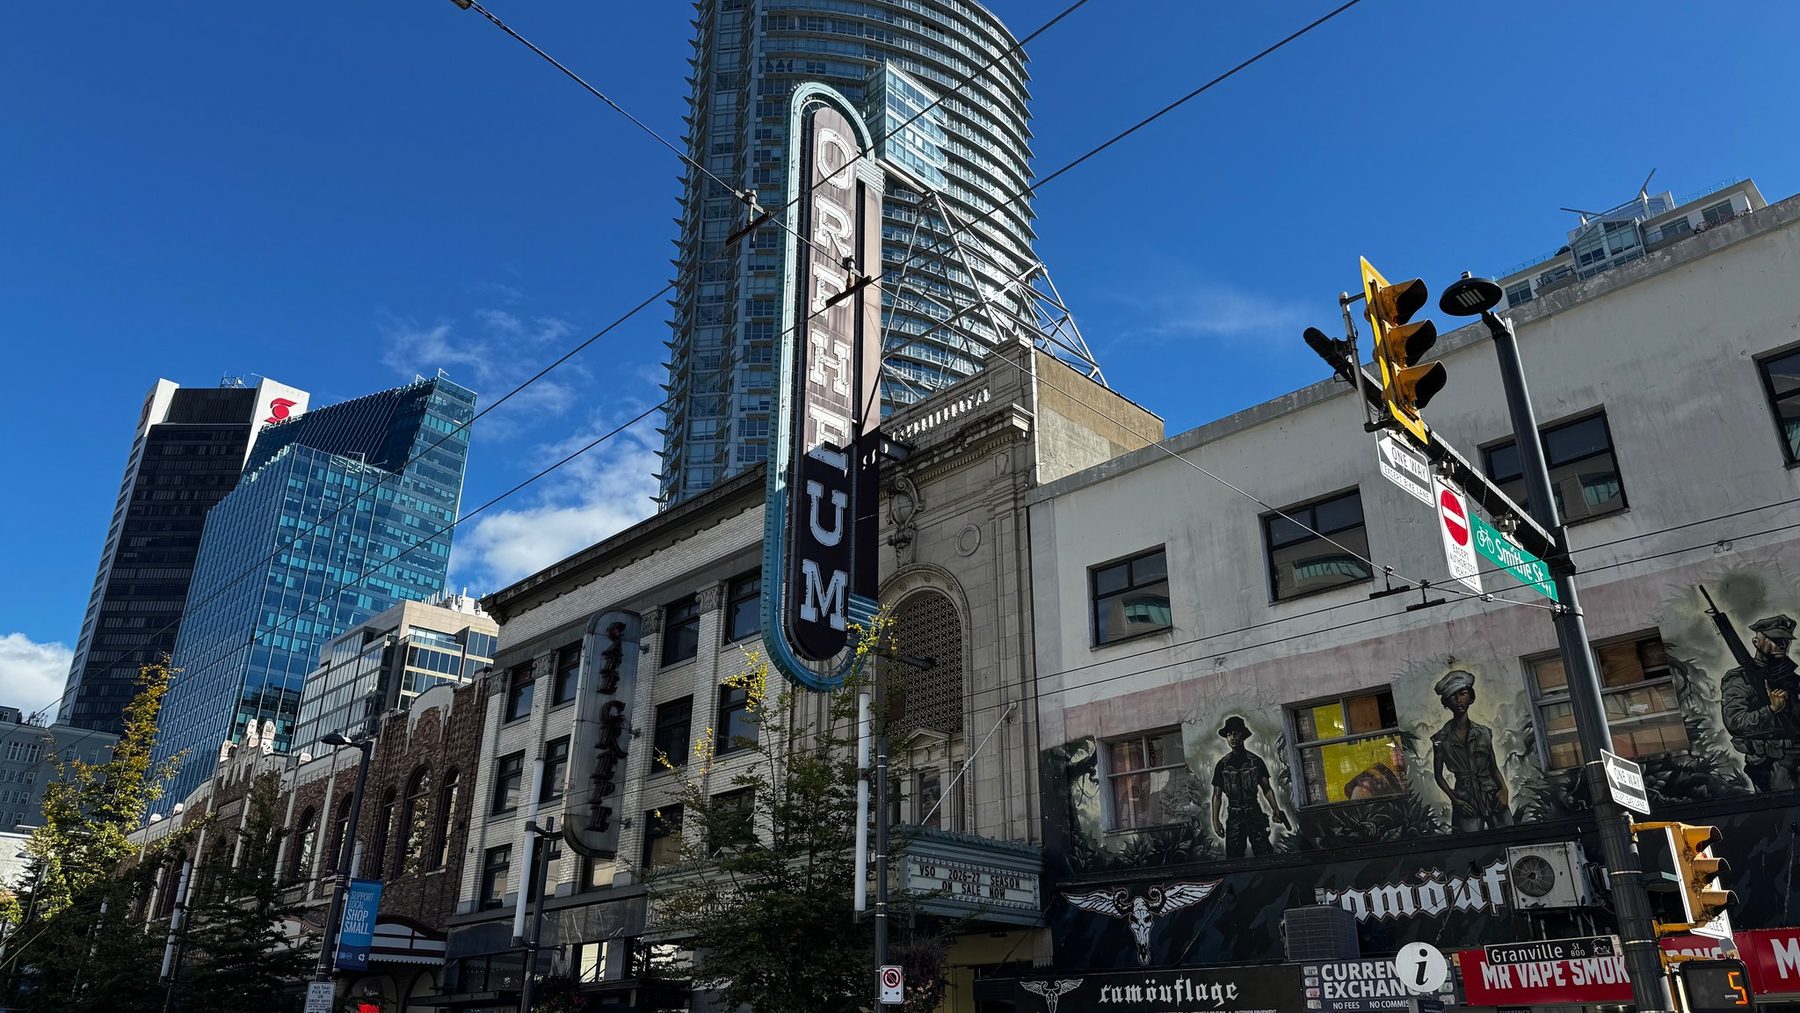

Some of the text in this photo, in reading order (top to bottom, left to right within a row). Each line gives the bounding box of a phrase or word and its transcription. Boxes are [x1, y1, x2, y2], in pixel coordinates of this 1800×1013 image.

[800, 127, 854, 632] ORPHEUM
[1392, 447, 1426, 479] ONE WAY
[1384, 465, 1430, 501] EXCEPT BIKE LANE
[1452, 544, 1469, 561] EXCEPT
[1496, 538, 1532, 580] Smithe
[584, 700, 629, 832] CREPE
[1614, 767, 1641, 789] ONE WAY
[919, 864, 1020, 889] VSO 2026-27 SEASON
[350, 891, 375, 901] SUPPORT
[941, 881, 1006, 899] ON SALE NOW
[346, 908, 368, 921] SHOP
[348, 901, 364, 909] LOCAL
[344, 921, 370, 935] SMALL
[1491, 944, 1563, 963] Granville
[1570, 949, 1586, 957] 800
[1321, 961, 1400, 982] CURREN
[1480, 956, 1631, 990] MR VAPE SMOK
[1098, 974, 1239, 1008] camöuflage
[1323, 979, 1420, 999] EXCHAN
[1727, 971, 1748, 1005] 5
[1332, 1000, 1409, 1010] NO FEES NO COMMIS
